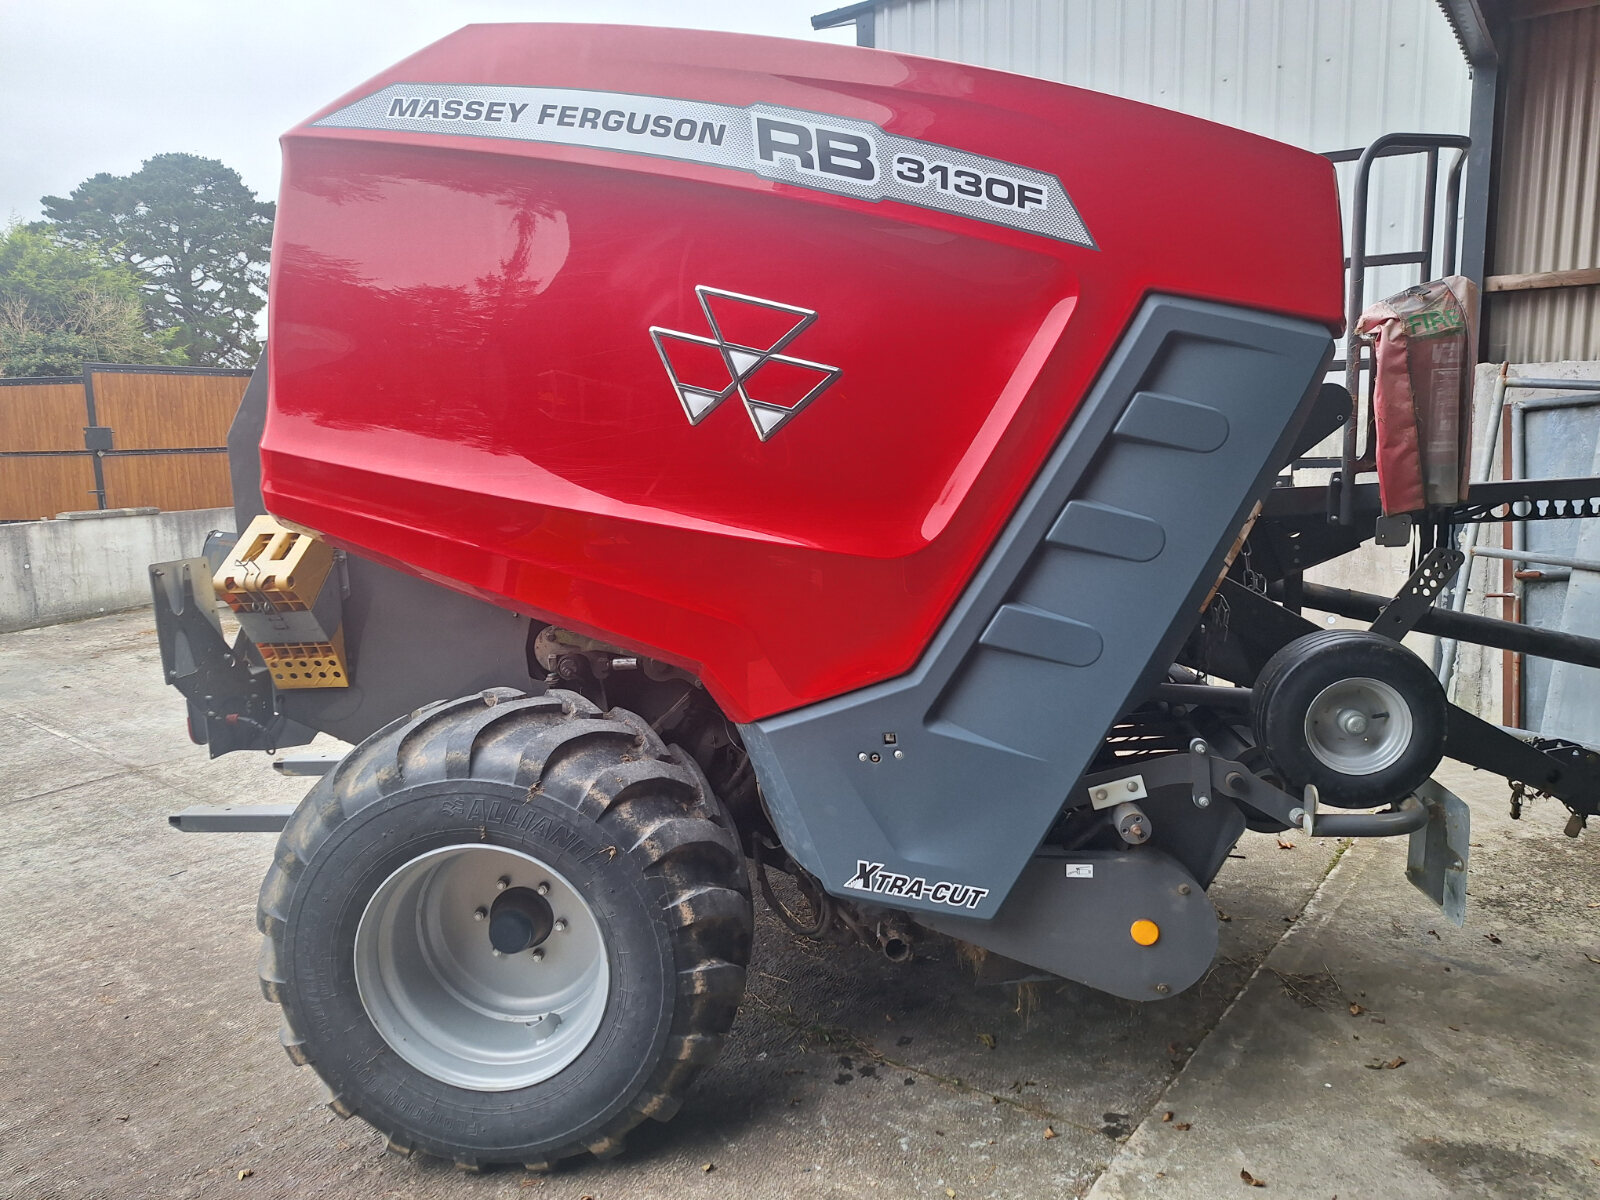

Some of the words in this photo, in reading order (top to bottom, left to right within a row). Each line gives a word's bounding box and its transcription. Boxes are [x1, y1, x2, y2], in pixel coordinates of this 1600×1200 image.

[388, 98, 529, 124] MASSEY
[537, 104, 727, 147] FERGUSON
[756, 116, 876, 182] RB
[896, 156, 1044, 210] 3130F
[845, 860, 989, 909] XTRA-CUT
